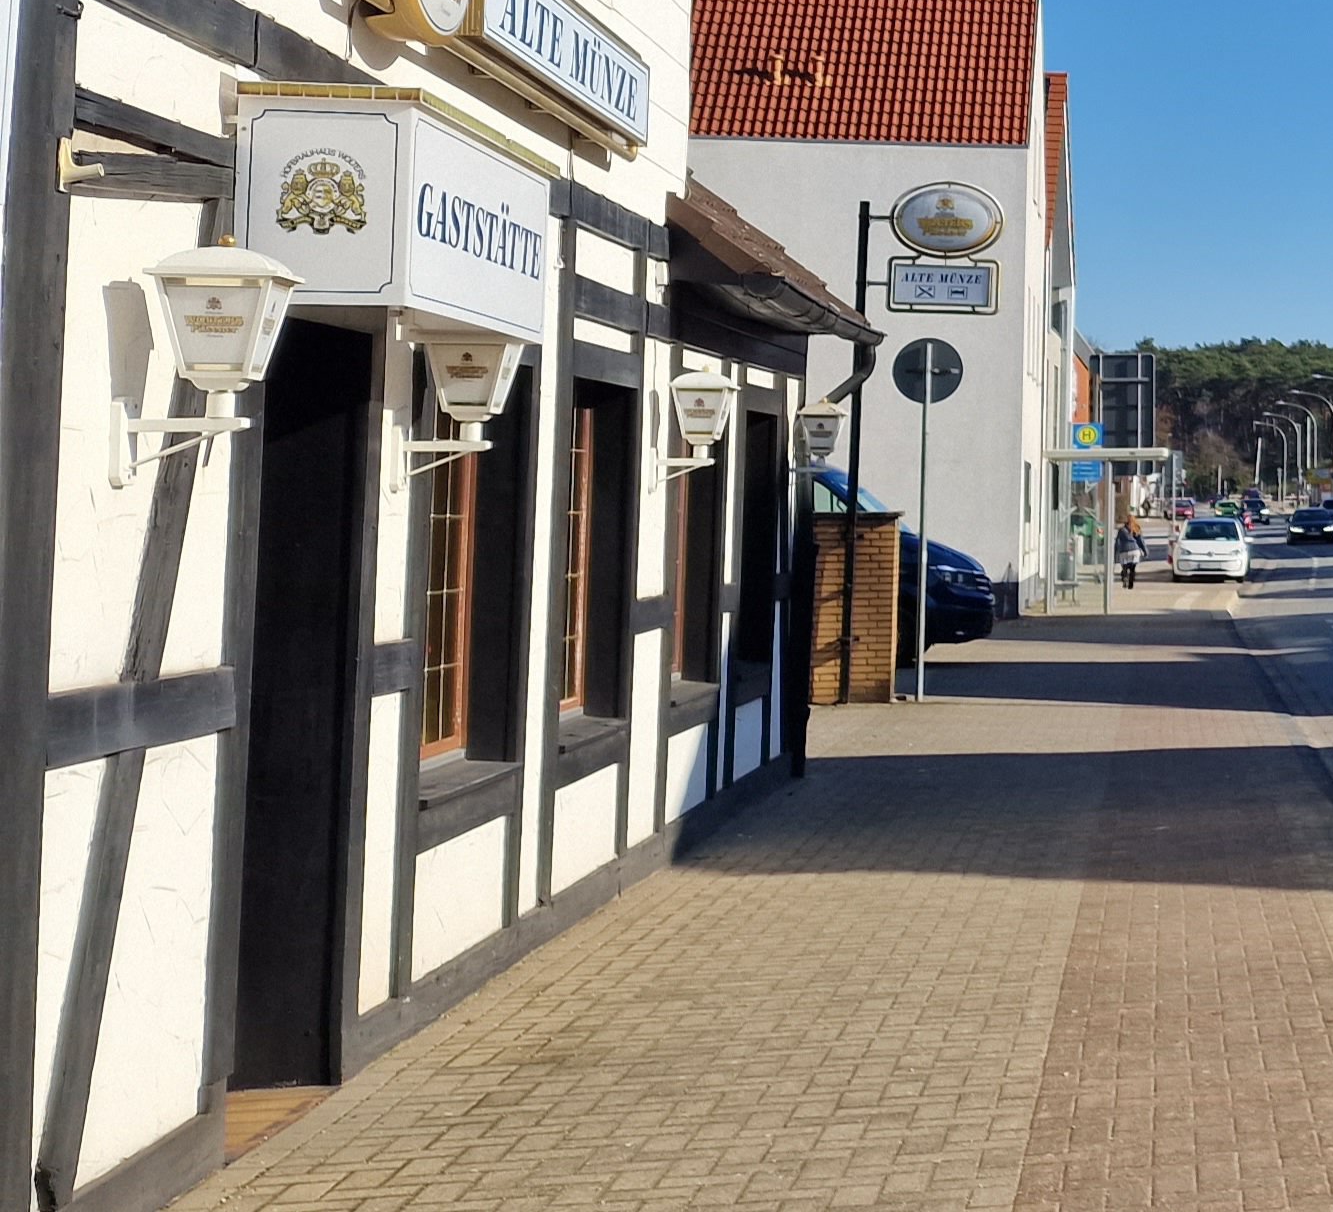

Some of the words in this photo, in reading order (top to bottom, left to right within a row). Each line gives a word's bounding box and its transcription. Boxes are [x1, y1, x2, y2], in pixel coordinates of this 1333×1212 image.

[569, 29, 638, 122] MÜNZE
[417, 183, 542, 280] GASTSTÄTTE
[902, 272, 934, 283] ALTE
[938, 272, 983, 285] MÜNZE
